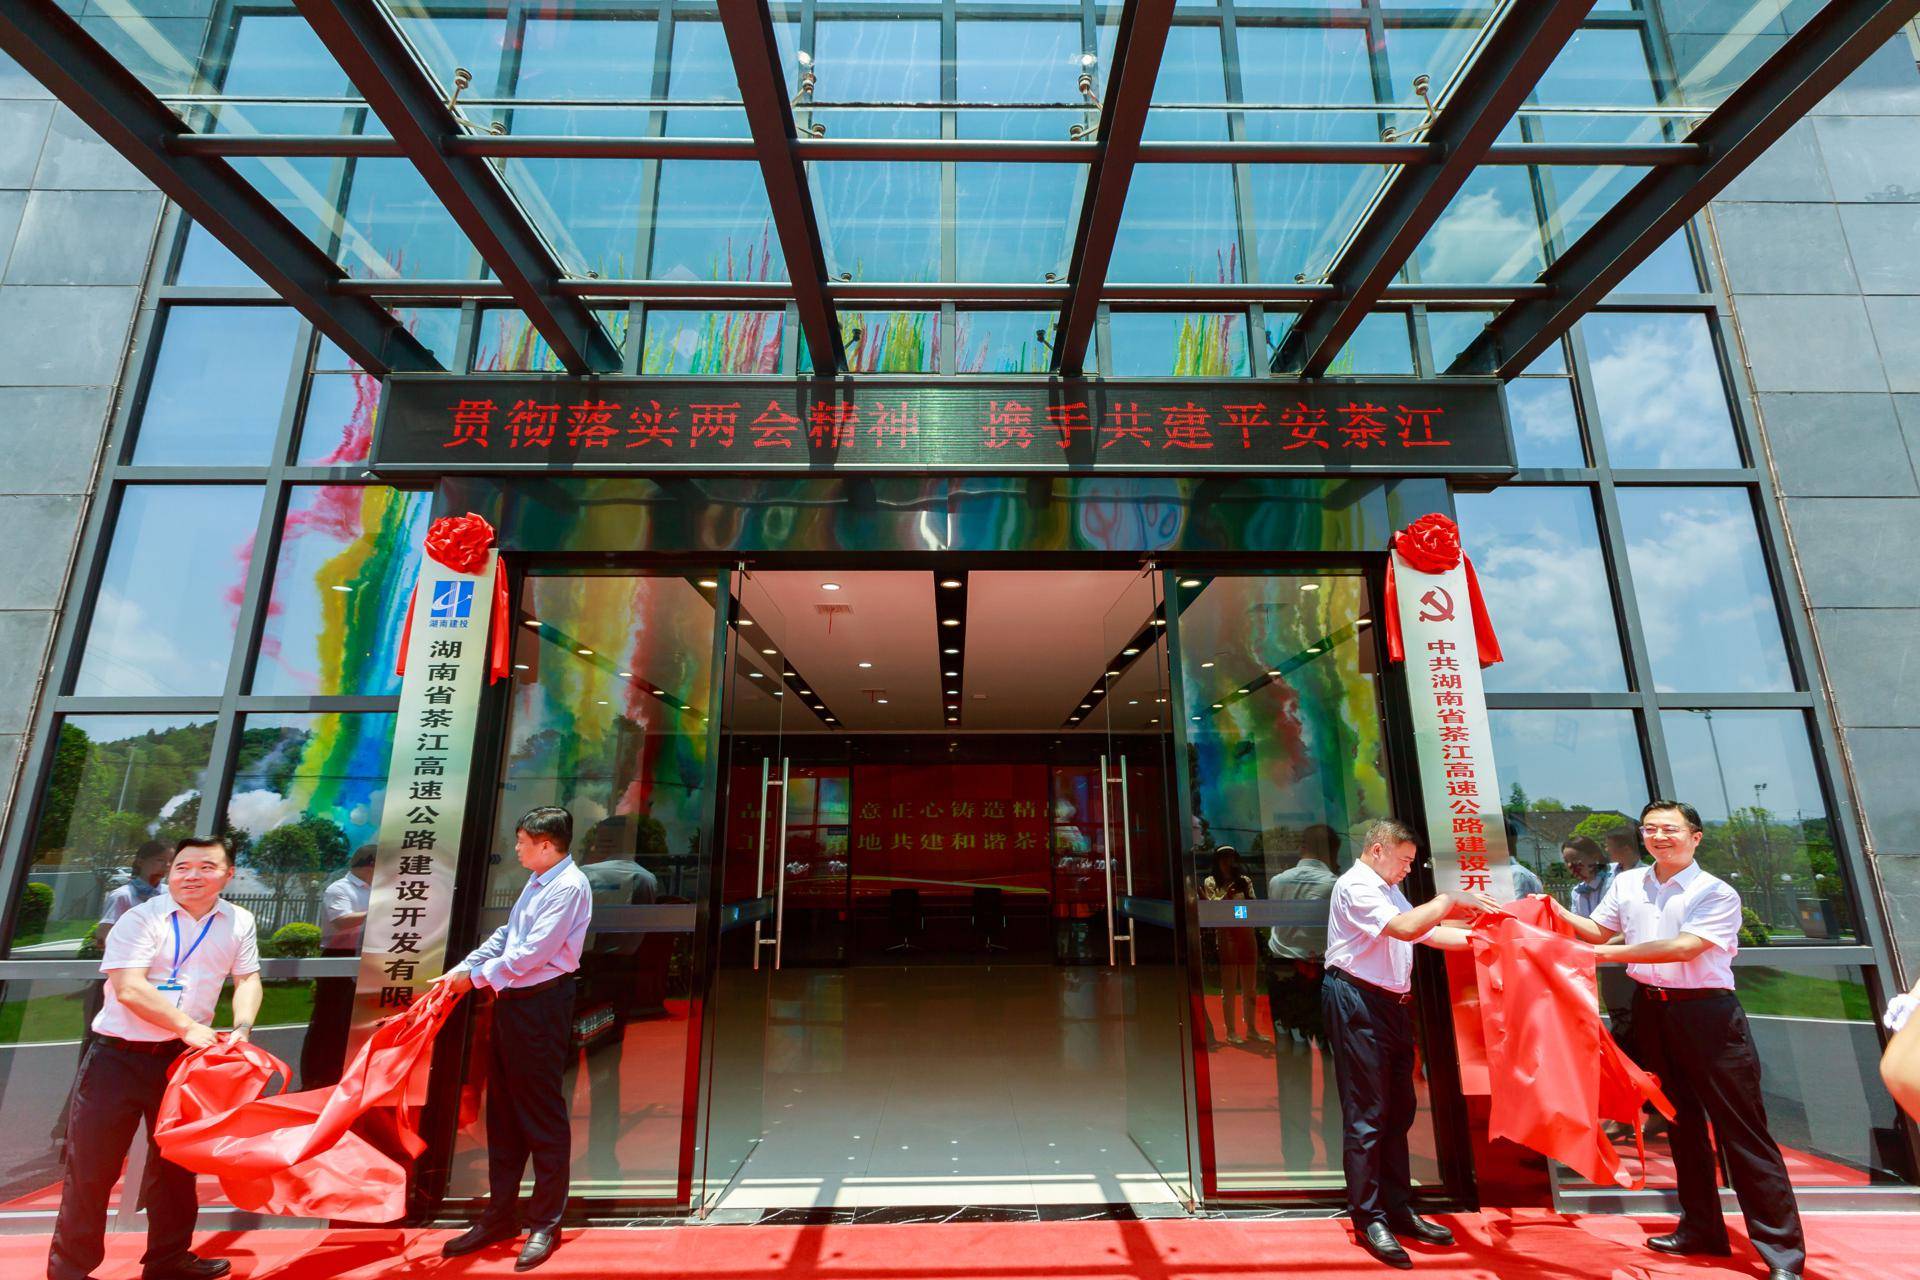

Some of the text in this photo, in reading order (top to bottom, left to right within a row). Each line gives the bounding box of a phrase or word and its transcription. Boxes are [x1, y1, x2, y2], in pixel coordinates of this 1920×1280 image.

[443, 400, 1451, 449] 贯彻落实两会精神 携手共建平安茶江
[376, 640, 463, 1026] 湖南省茶江高速公路建设开发有限
[858, 801, 1050, 820] 意正心铸造精
[1427, 639, 1492, 924] 中共湖南省茶江高速公路建设开
